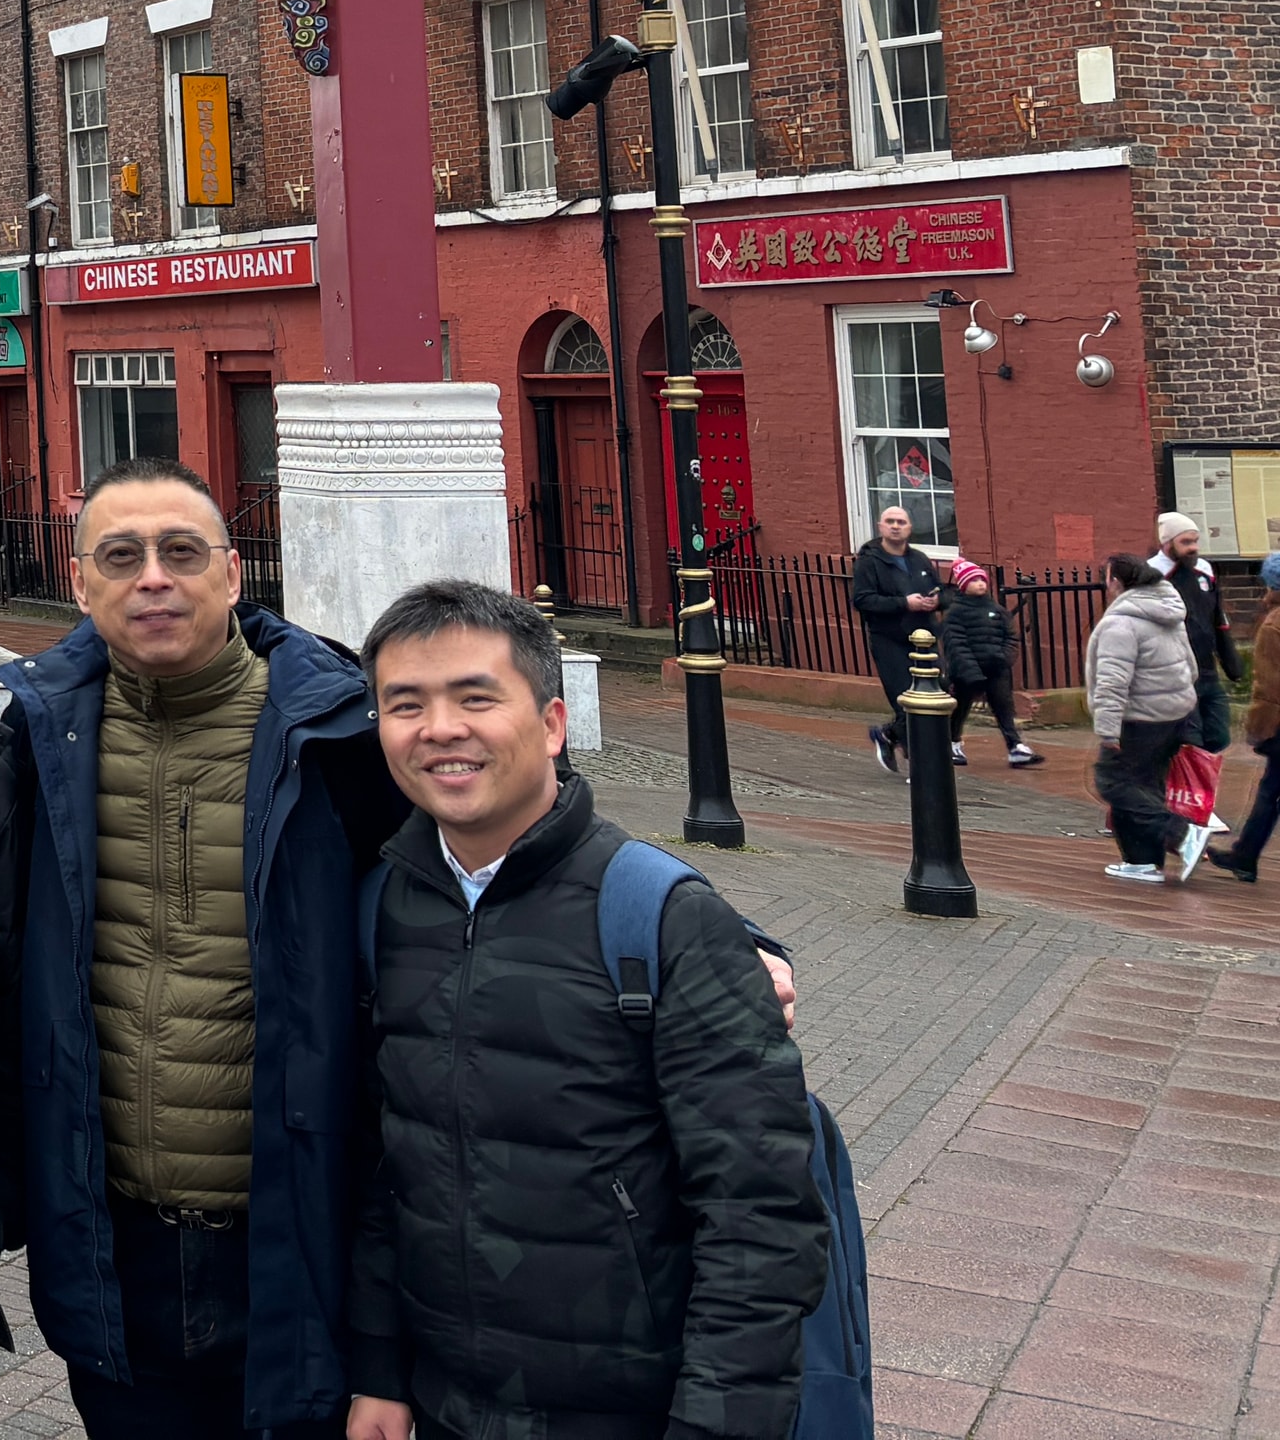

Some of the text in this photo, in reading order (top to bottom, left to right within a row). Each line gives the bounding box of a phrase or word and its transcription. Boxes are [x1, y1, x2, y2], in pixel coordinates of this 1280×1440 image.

[928, 211, 983, 227] CHINESE
[920, 228, 995, 245] FREEMASON
[948, 247, 973, 260] U.K.
[84, 249, 296, 291] CHINESE RESTAURANT
[1165, 787, 1203, 807] HES
